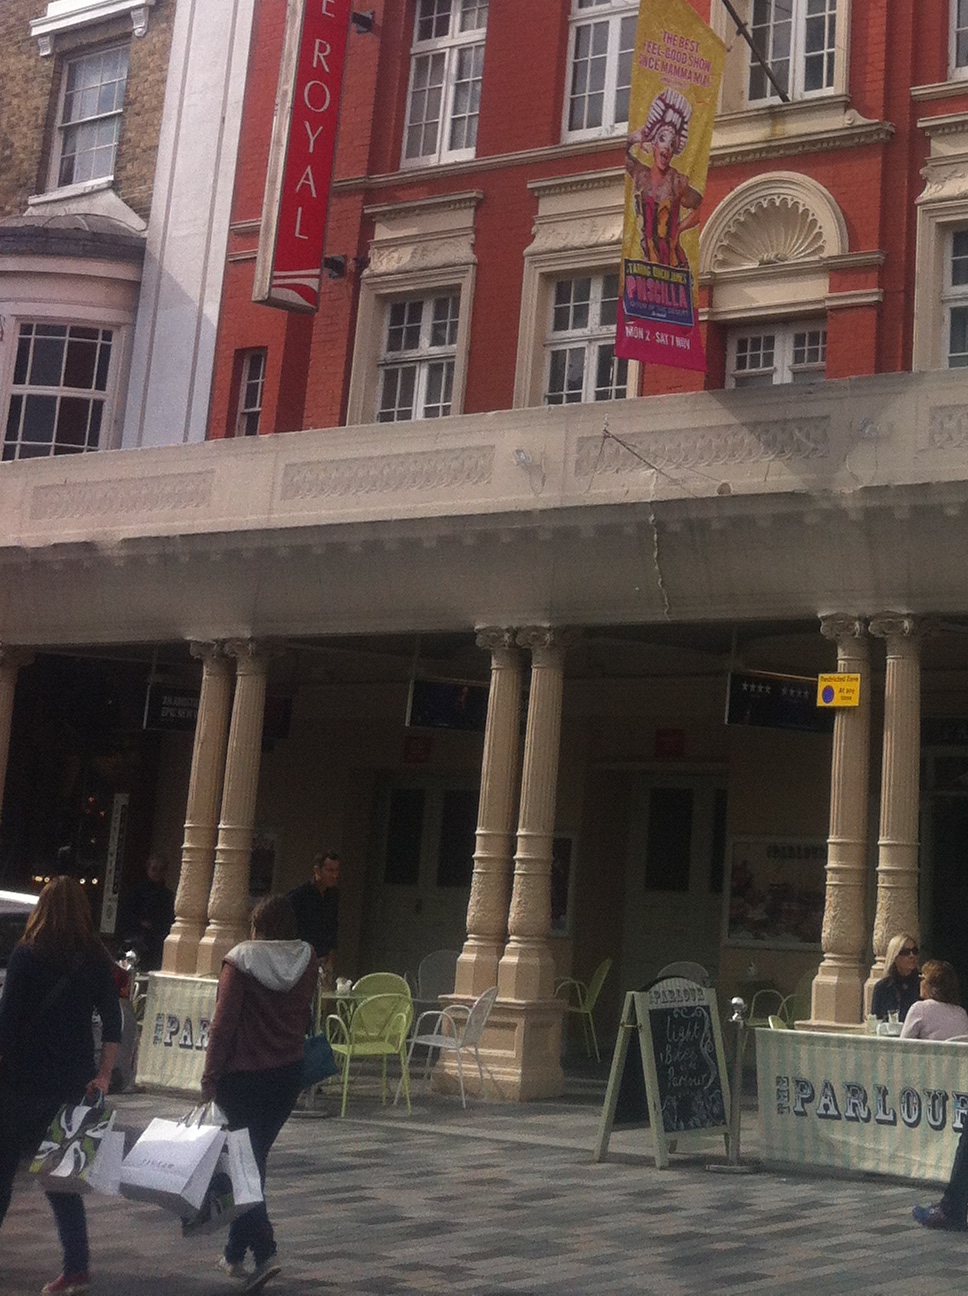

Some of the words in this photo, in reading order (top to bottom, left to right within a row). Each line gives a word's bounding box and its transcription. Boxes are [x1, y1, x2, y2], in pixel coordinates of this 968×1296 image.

[679, 36, 700, 53] BEST
[294, 38, 332, 240] ROYAL
[625, 276, 689, 309] PRISCILLA
[625, 325, 644, 340] MON
[645, 329, 651, 342] 2
